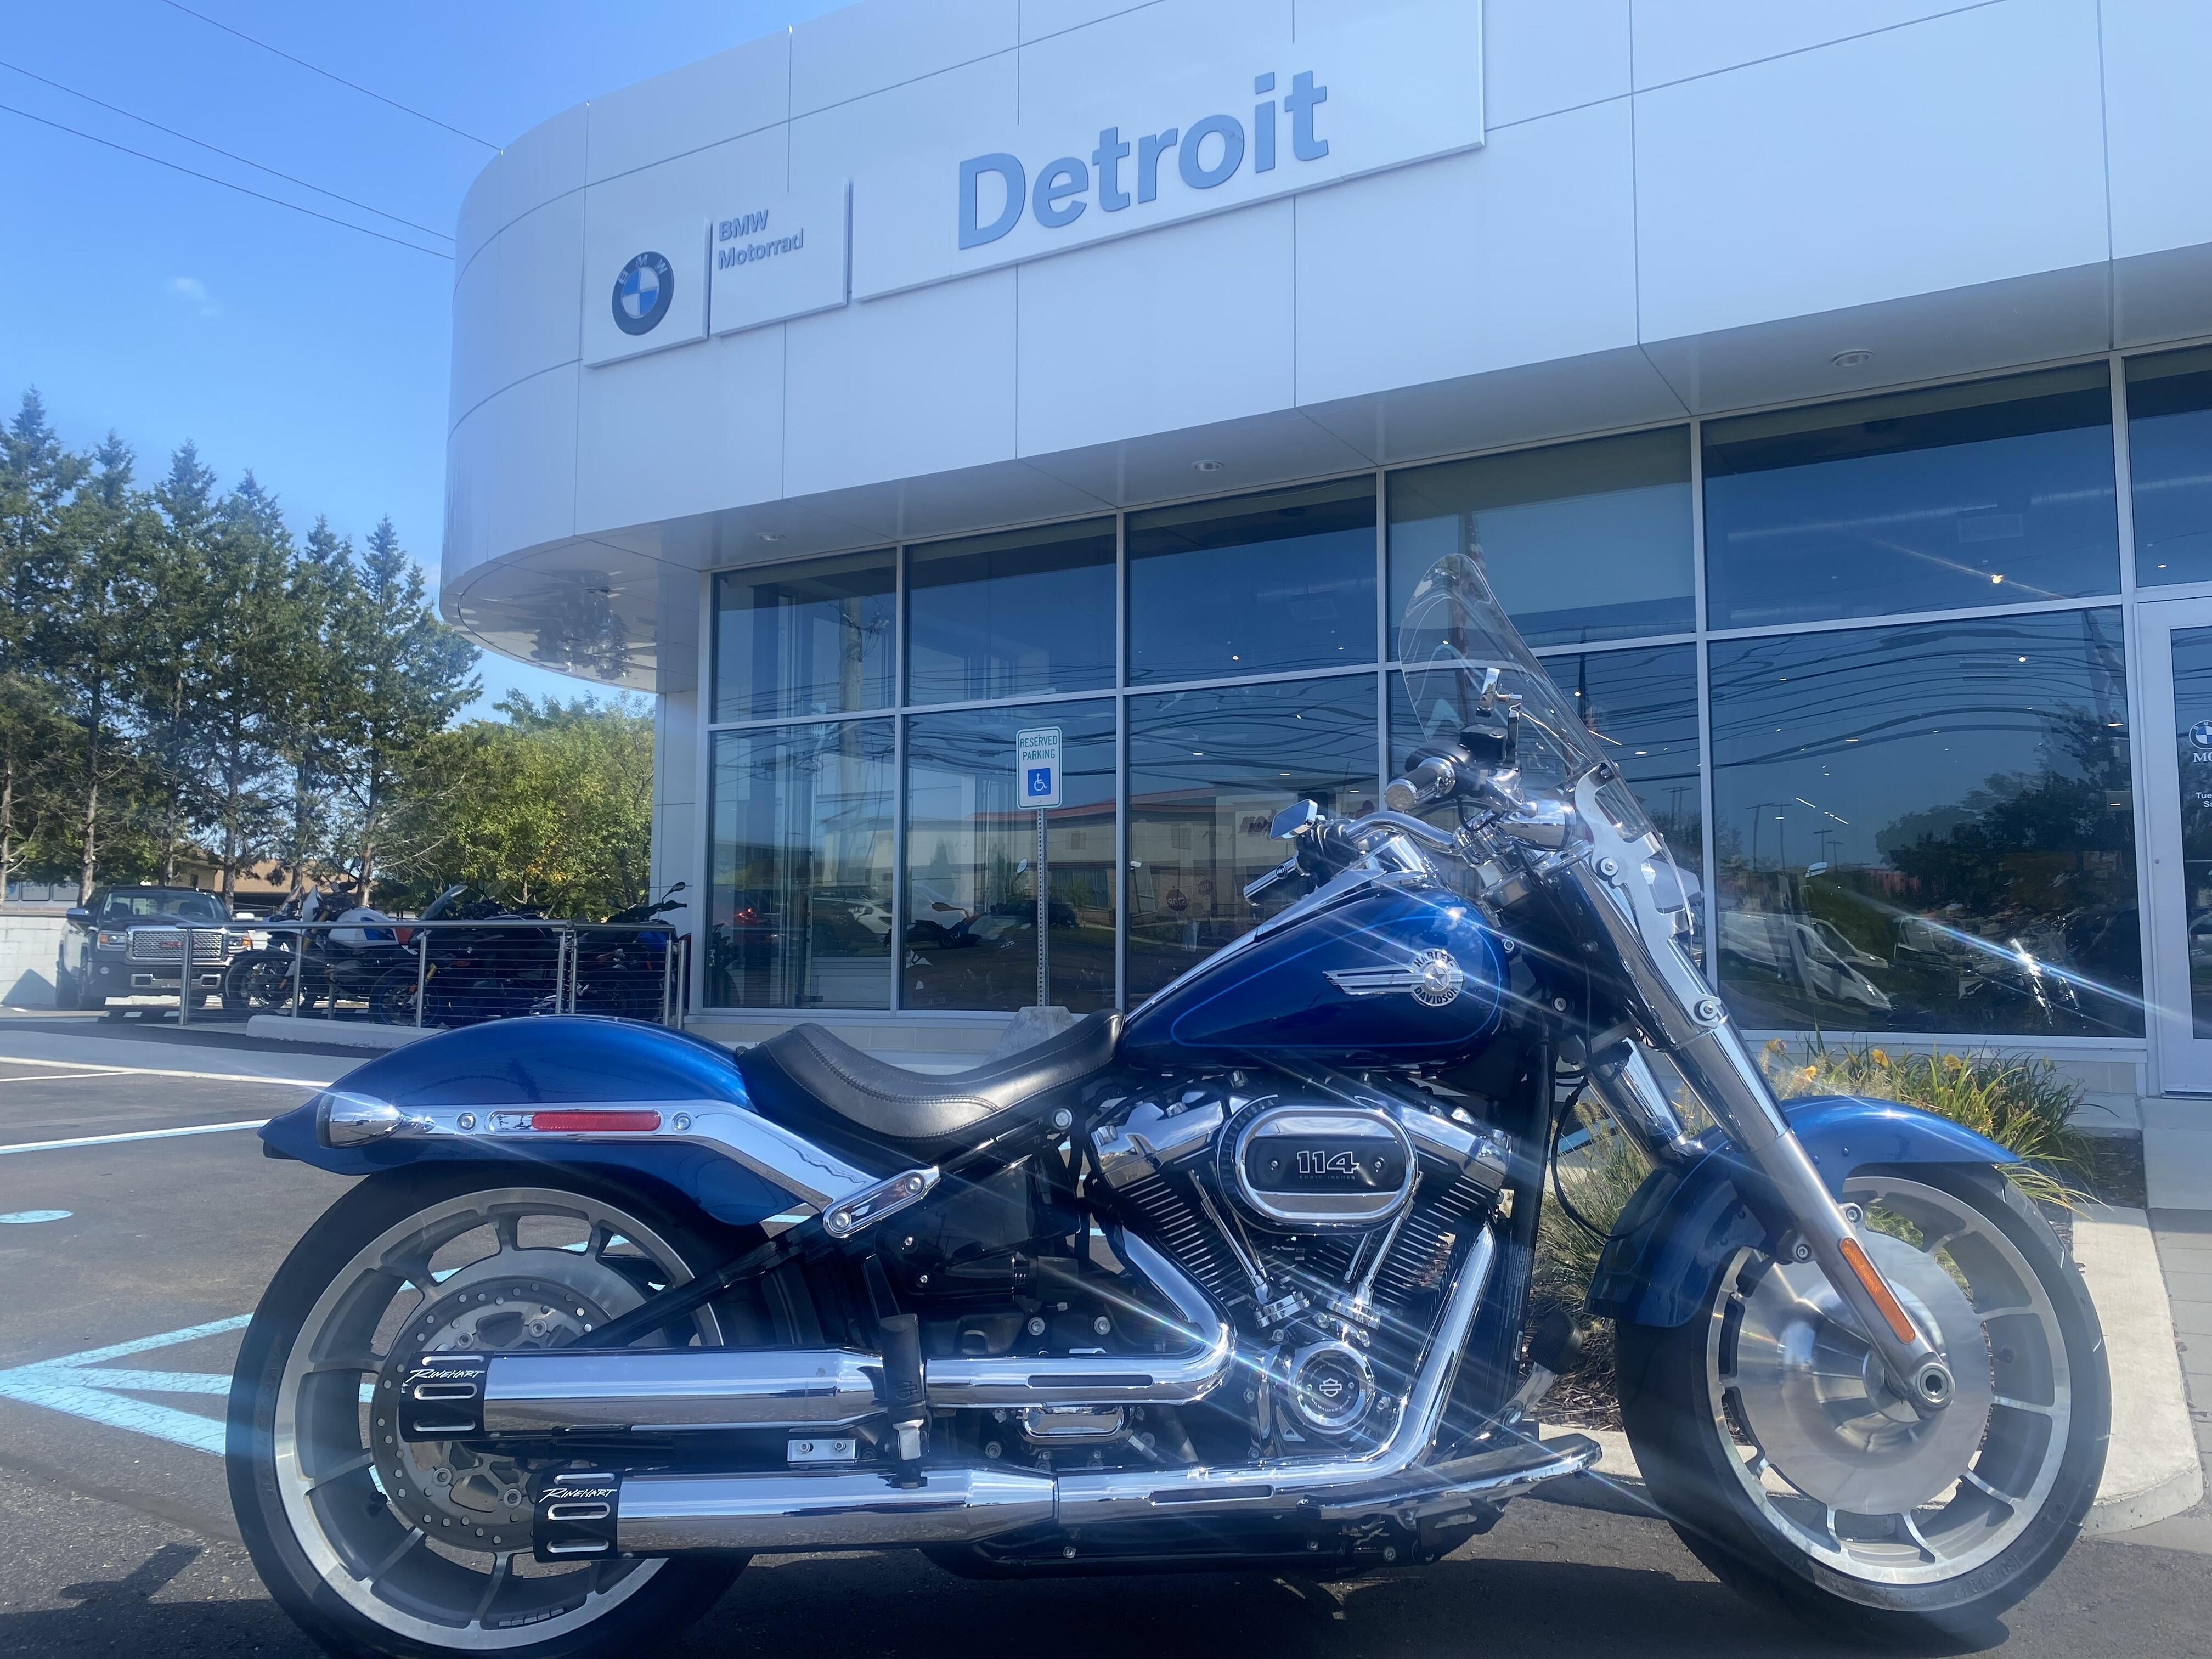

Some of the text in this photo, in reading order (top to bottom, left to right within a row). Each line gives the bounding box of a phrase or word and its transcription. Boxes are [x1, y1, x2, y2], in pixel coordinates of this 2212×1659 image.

[958, 70, 1329, 250] Detroit
[718, 209, 769, 242] BMW
[718, 228, 804, 270] Motorrad
[617, 254, 668, 284] BMW
[2194, 721, 2209, 730] BM
[1020, 735, 1058, 748] RESERVED
[1023, 749, 1056, 761] PARKING
[1414, 986, 1458, 1005] DAVIDSON
[1296, 1150, 1360, 1174] 114
[405, 1368, 486, 1383] RINEHART
[538, 1487, 617, 1503] RINEHART
